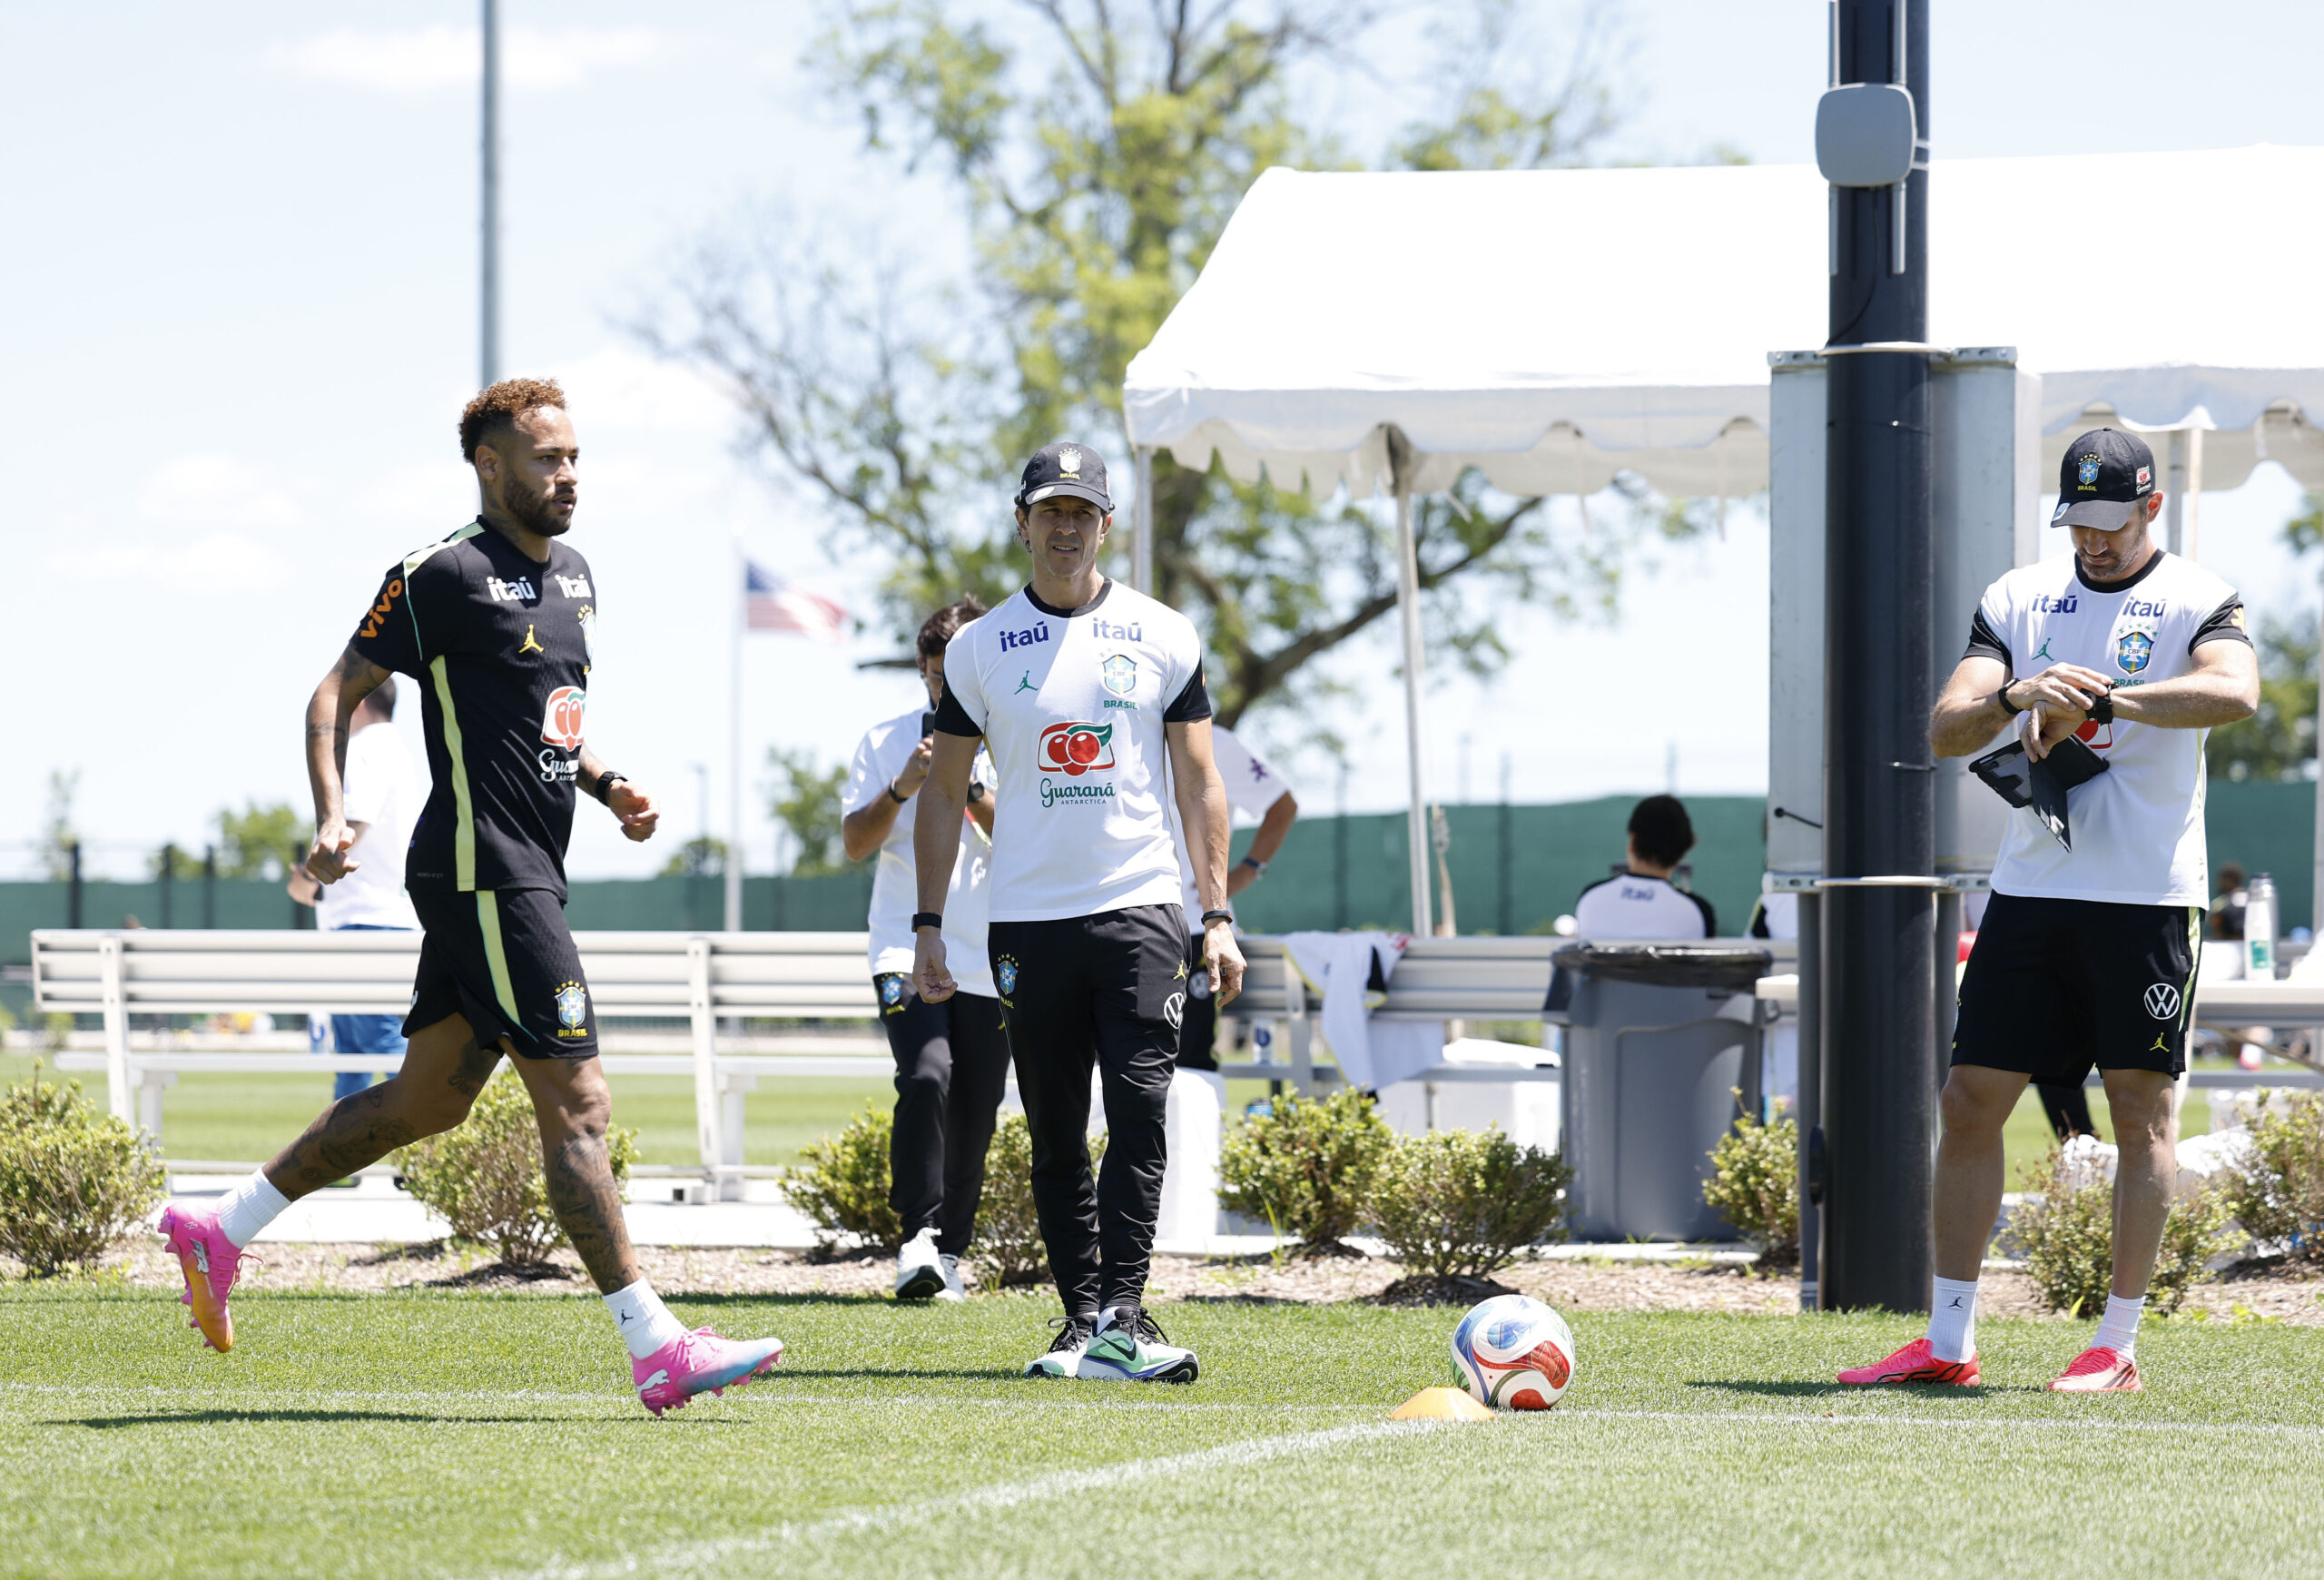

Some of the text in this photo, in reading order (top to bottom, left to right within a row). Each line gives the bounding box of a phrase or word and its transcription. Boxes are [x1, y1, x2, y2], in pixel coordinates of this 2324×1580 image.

[487, 576, 537, 601] itaú
[555, 574, 592, 598] itaú
[360, 579, 402, 637] vivo
[2032, 594, 2078, 614] itaú
[2122, 596, 2167, 617] itaú
[1000, 621, 1049, 652] itaú
[1093, 617, 1142, 642] itaú
[1103, 700, 1137, 710] BRASIL
[1040, 778, 1116, 808] Guaraná
[557, 1028, 588, 1038] BRASIL
